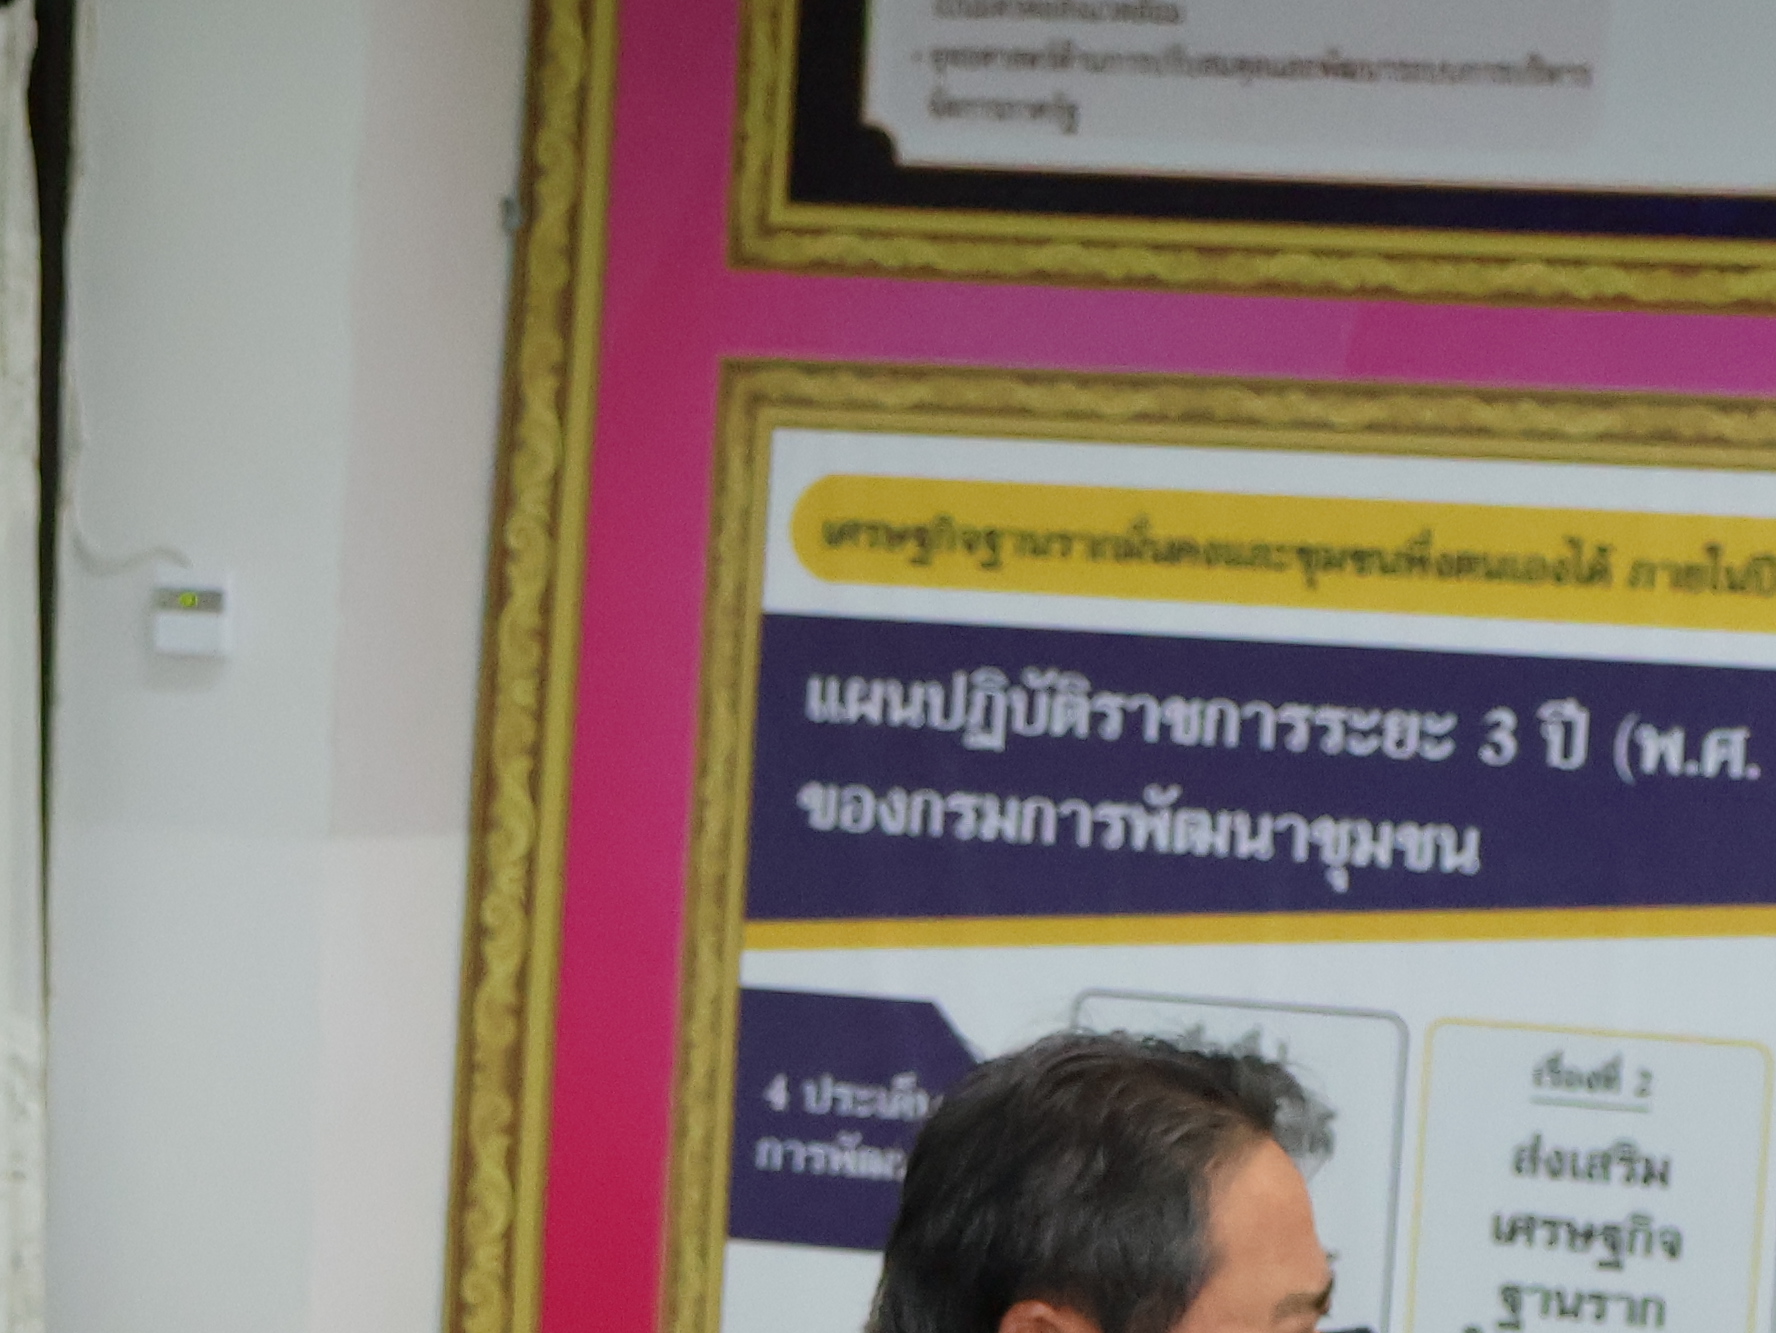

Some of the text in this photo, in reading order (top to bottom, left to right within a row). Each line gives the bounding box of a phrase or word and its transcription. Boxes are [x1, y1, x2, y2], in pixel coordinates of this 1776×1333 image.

[806, 668, 1458, 761] แผนปฏิบัติราชการระยะ
[1478, 706, 1519, 766] 3
[1536, 698, 1590, 770] ปี
[1615, 713, 1762, 784] (พ.ศ.
[798, 783, 1481, 892] ของกรมการพัฒนาชุมชน
[765, 1074, 789, 1112] 4
[1635, 1068, 1652, 1098] 2
[1513, 1133, 1671, 1190] ส่งเสริม
[1492, 1207, 1684, 1270] เศรษฐกิจ
[1497, 1282, 1667, 1332] ฐานราก
